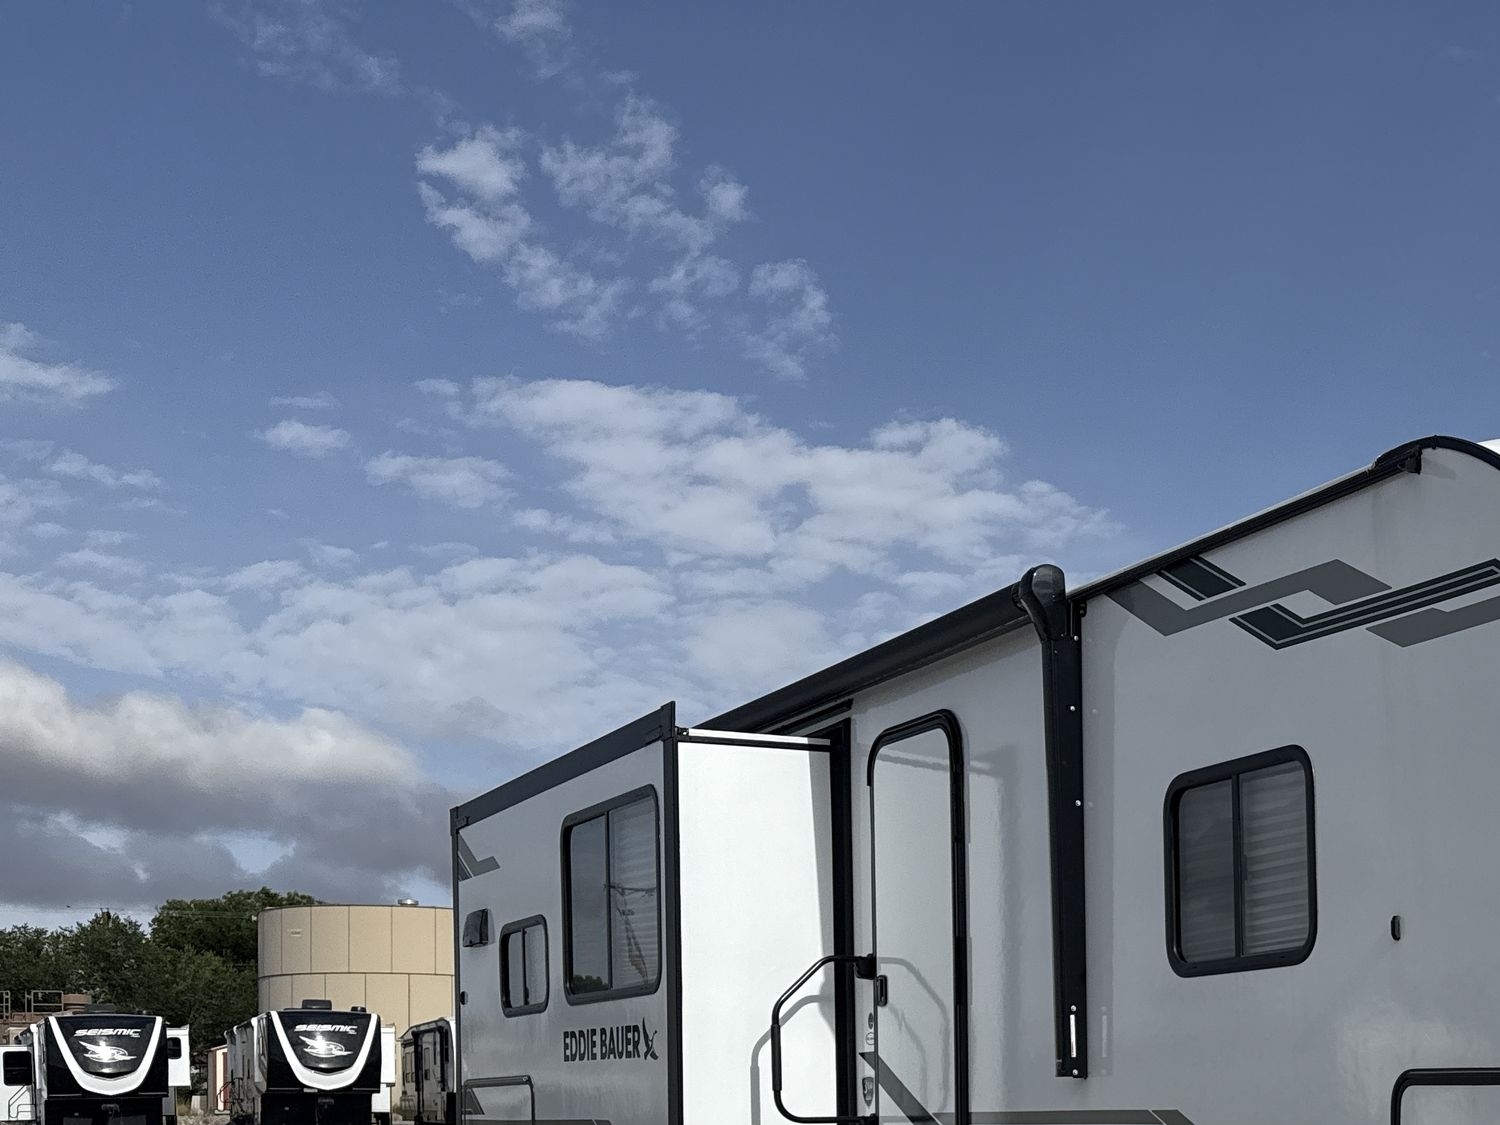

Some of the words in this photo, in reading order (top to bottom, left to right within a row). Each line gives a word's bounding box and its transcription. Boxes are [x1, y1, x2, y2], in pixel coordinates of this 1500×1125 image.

[74, 1028, 142, 1037] SEISMIC
[294, 1024, 358, 1032] SEISMIC
[563, 1028, 598, 1062] EDDIE
[600, 1024, 641, 1060] BAUER
